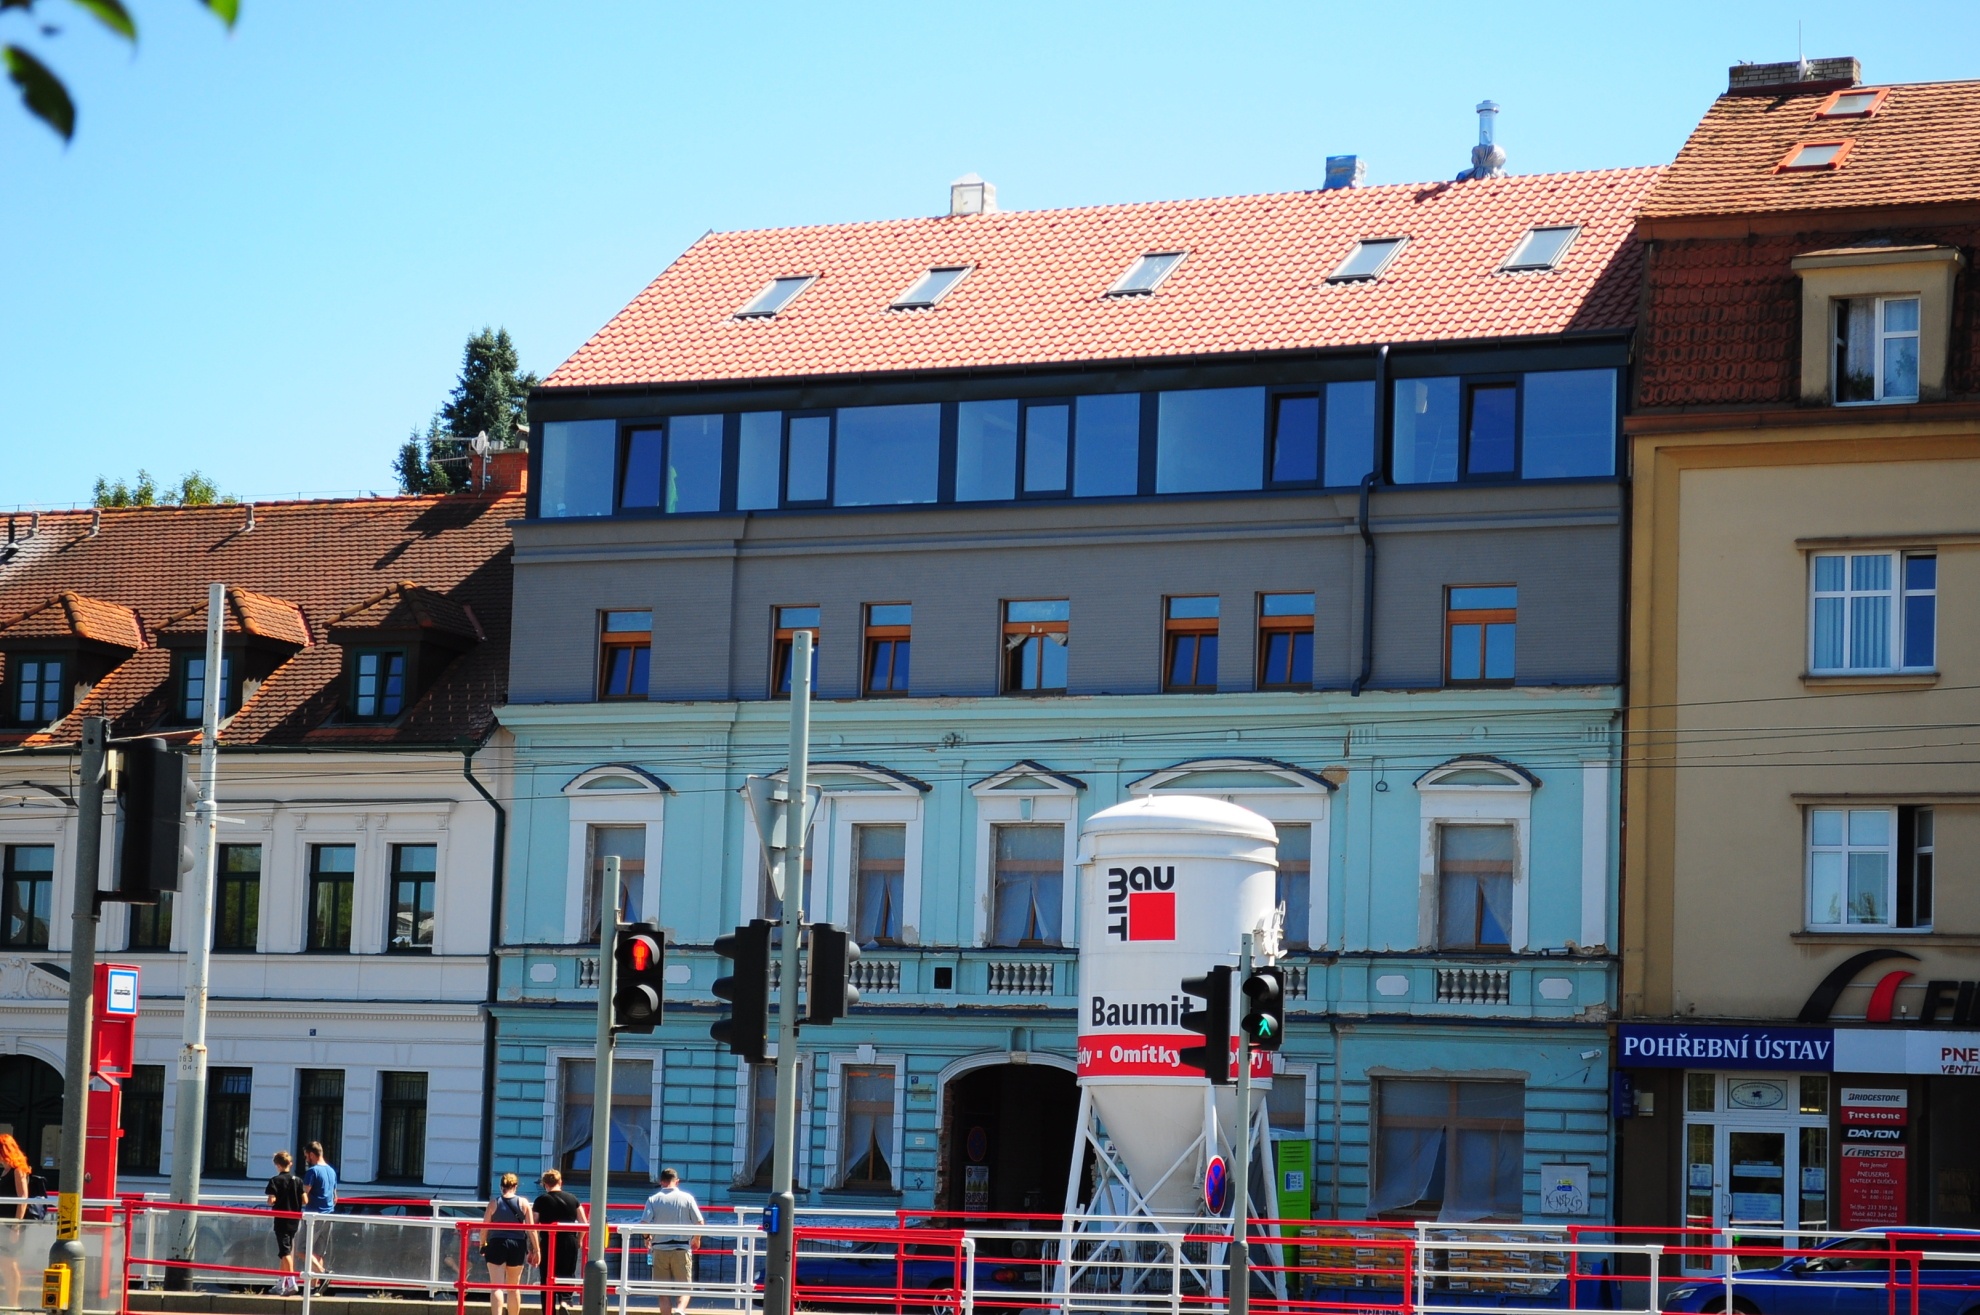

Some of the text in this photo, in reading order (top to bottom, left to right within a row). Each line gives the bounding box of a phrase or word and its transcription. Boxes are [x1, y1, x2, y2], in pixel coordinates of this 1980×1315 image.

[1092, 995, 1194, 1026] Baumit
[1921, 981, 1980, 1023] FI
[1110, 1044, 1182, 1068] Omítky
[1624, 1033, 1831, 1060] POHŘEBNÍ ÚSTAV
[1848, 1093, 1901, 1102] BRIDGESTONE
[1847, 1129, 1900, 1139] DAYTON
